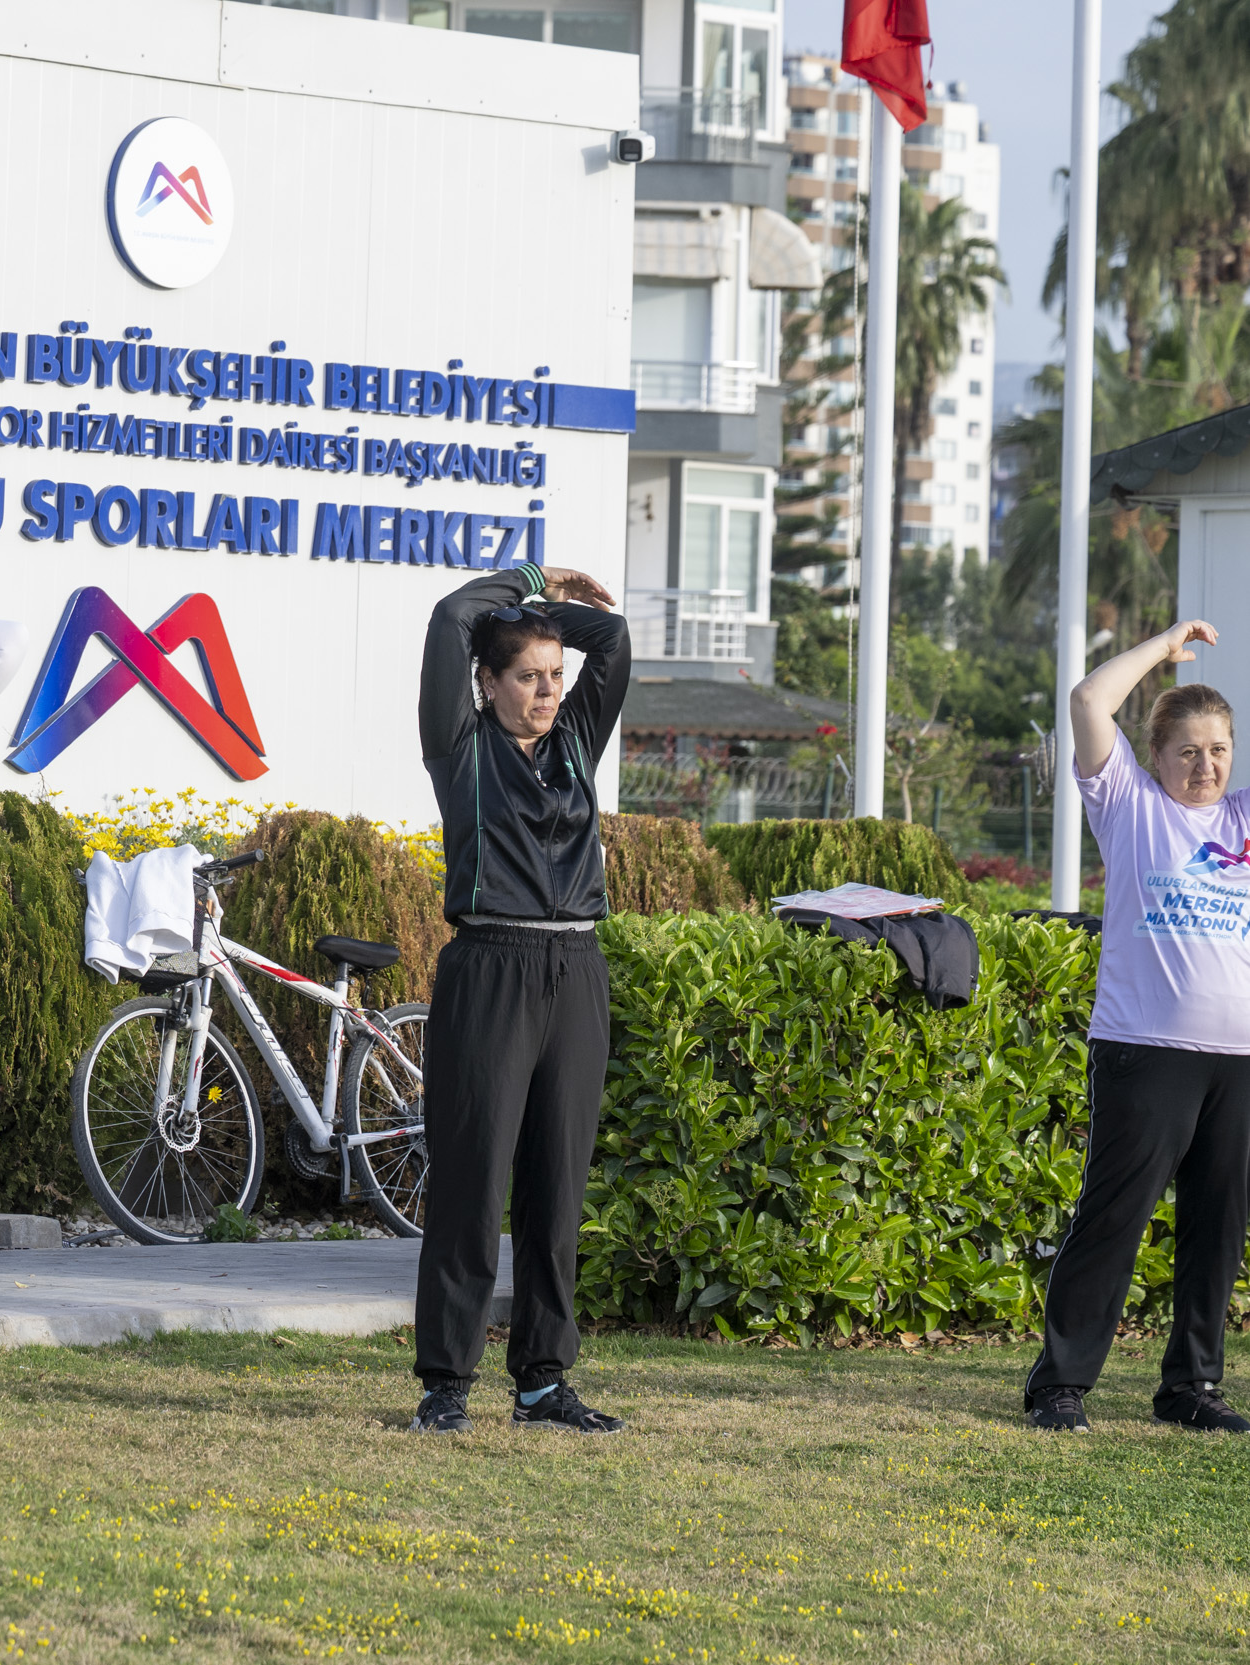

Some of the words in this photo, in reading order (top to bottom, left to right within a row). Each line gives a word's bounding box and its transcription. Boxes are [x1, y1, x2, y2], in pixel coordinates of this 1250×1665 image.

[26, 320, 315, 410] BÜYÜKŞEHİR
[324, 359, 551, 428] BELEDİYESİ
[48, 403, 234, 462] HİZMETLERİ
[239, 421, 359, 474] DAİRESİ
[364, 438, 547, 487] BAŞKANLIĞI
[21, 479, 300, 556] SPORLARI
[311, 499, 546, 572] MERKEZİ
[1145, 912, 1237, 931] MARATONU
[1162, 892, 1244, 916] MERSİN
